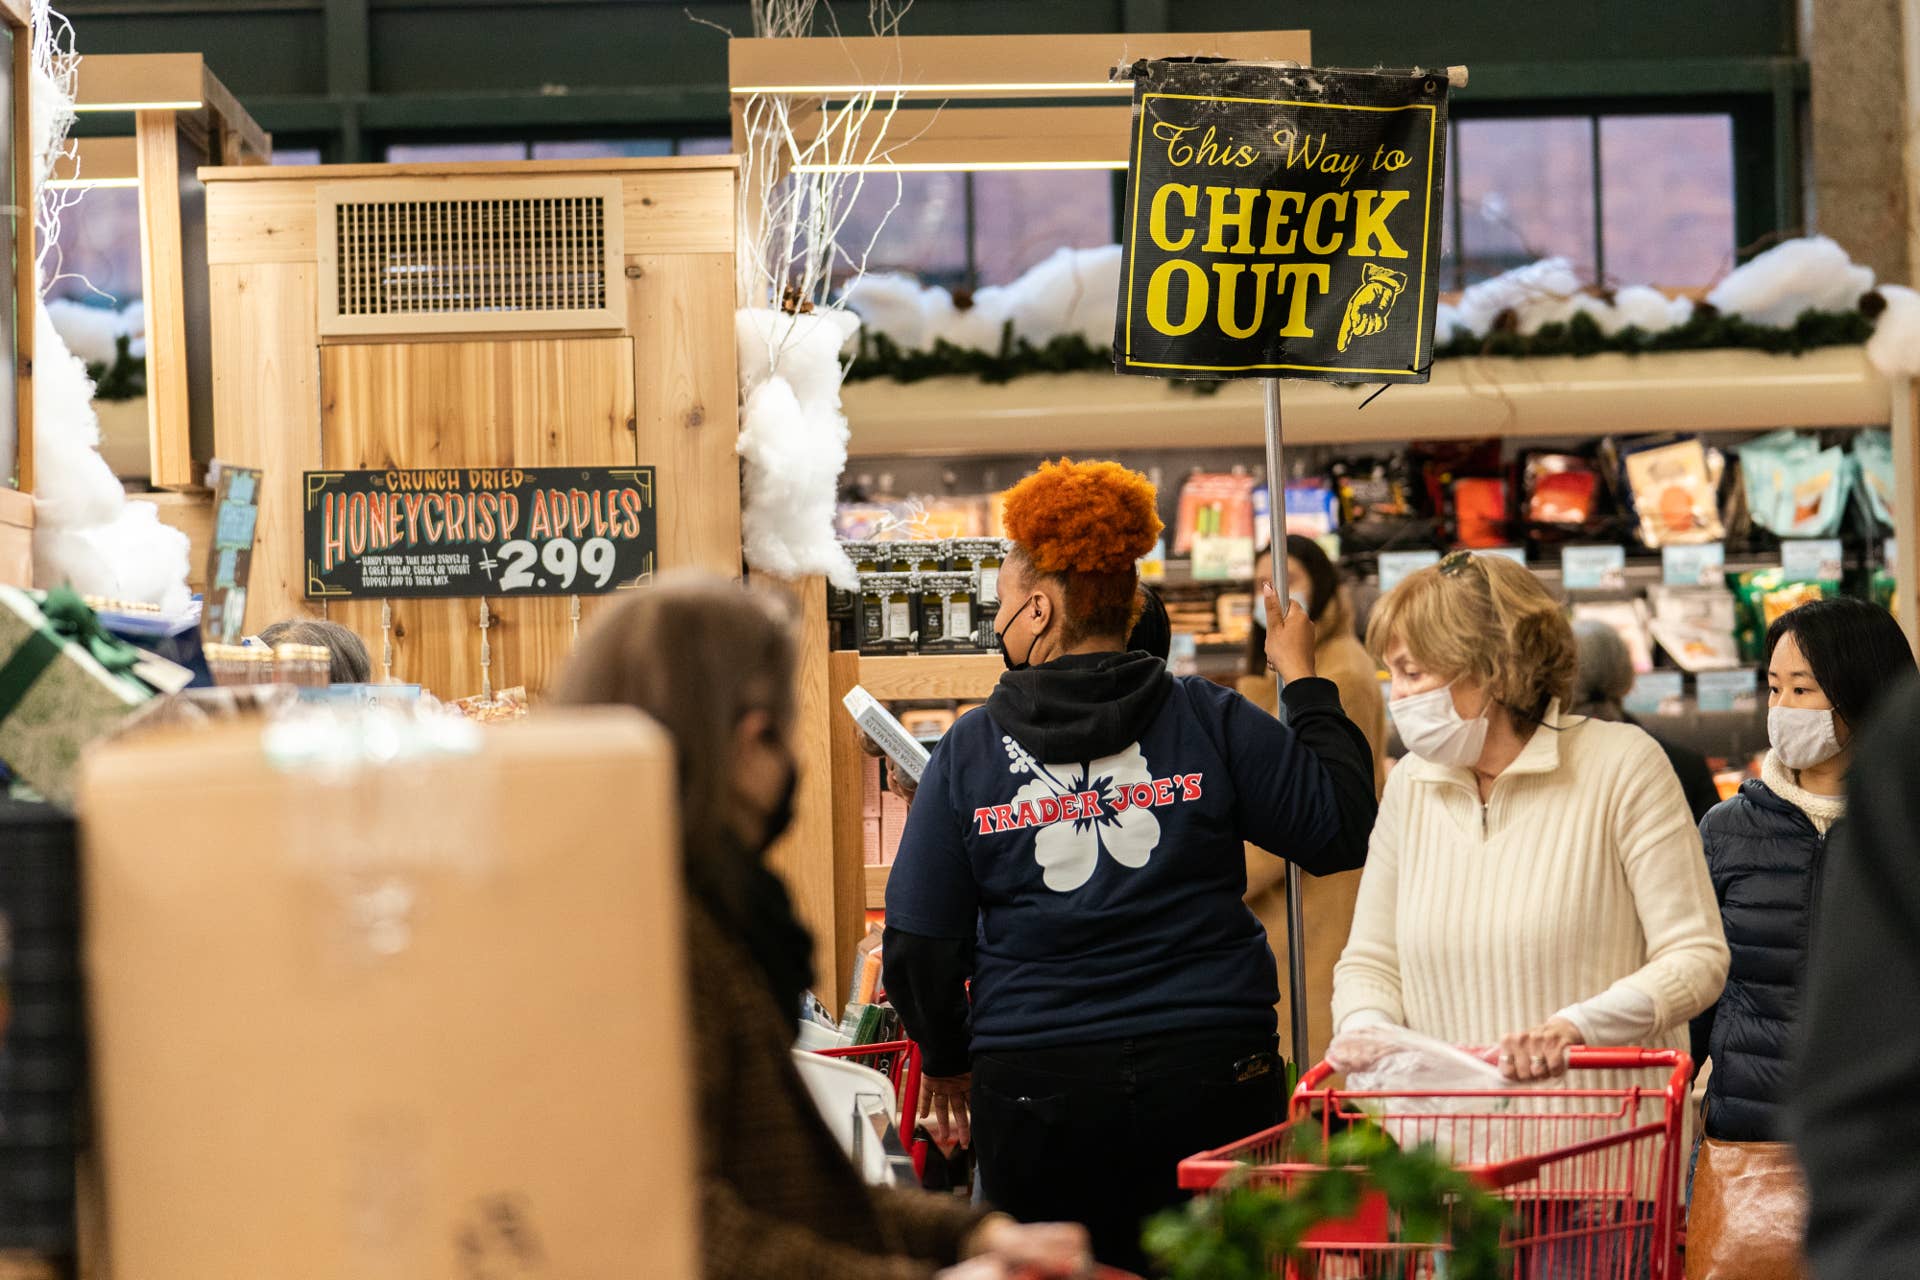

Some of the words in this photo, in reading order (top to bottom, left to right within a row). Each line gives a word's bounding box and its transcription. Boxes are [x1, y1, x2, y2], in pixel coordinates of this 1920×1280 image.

[1153, 121, 1261, 168] This
[1273, 129, 1364, 187] Way
[1372, 144, 1414, 172] to
[1149, 182, 1410, 259] CHECK
[1146, 259, 1331, 340] OUT
[385, 470, 461, 492] CRUNCH
[468, 469, 524, 490] DRIED
[322, 490, 520, 572] HONEYCRISP
[529, 488, 642, 540] APPLES
[973, 789, 1104, 835] TRADER
[1108, 772, 1203, 813] JOE'S
